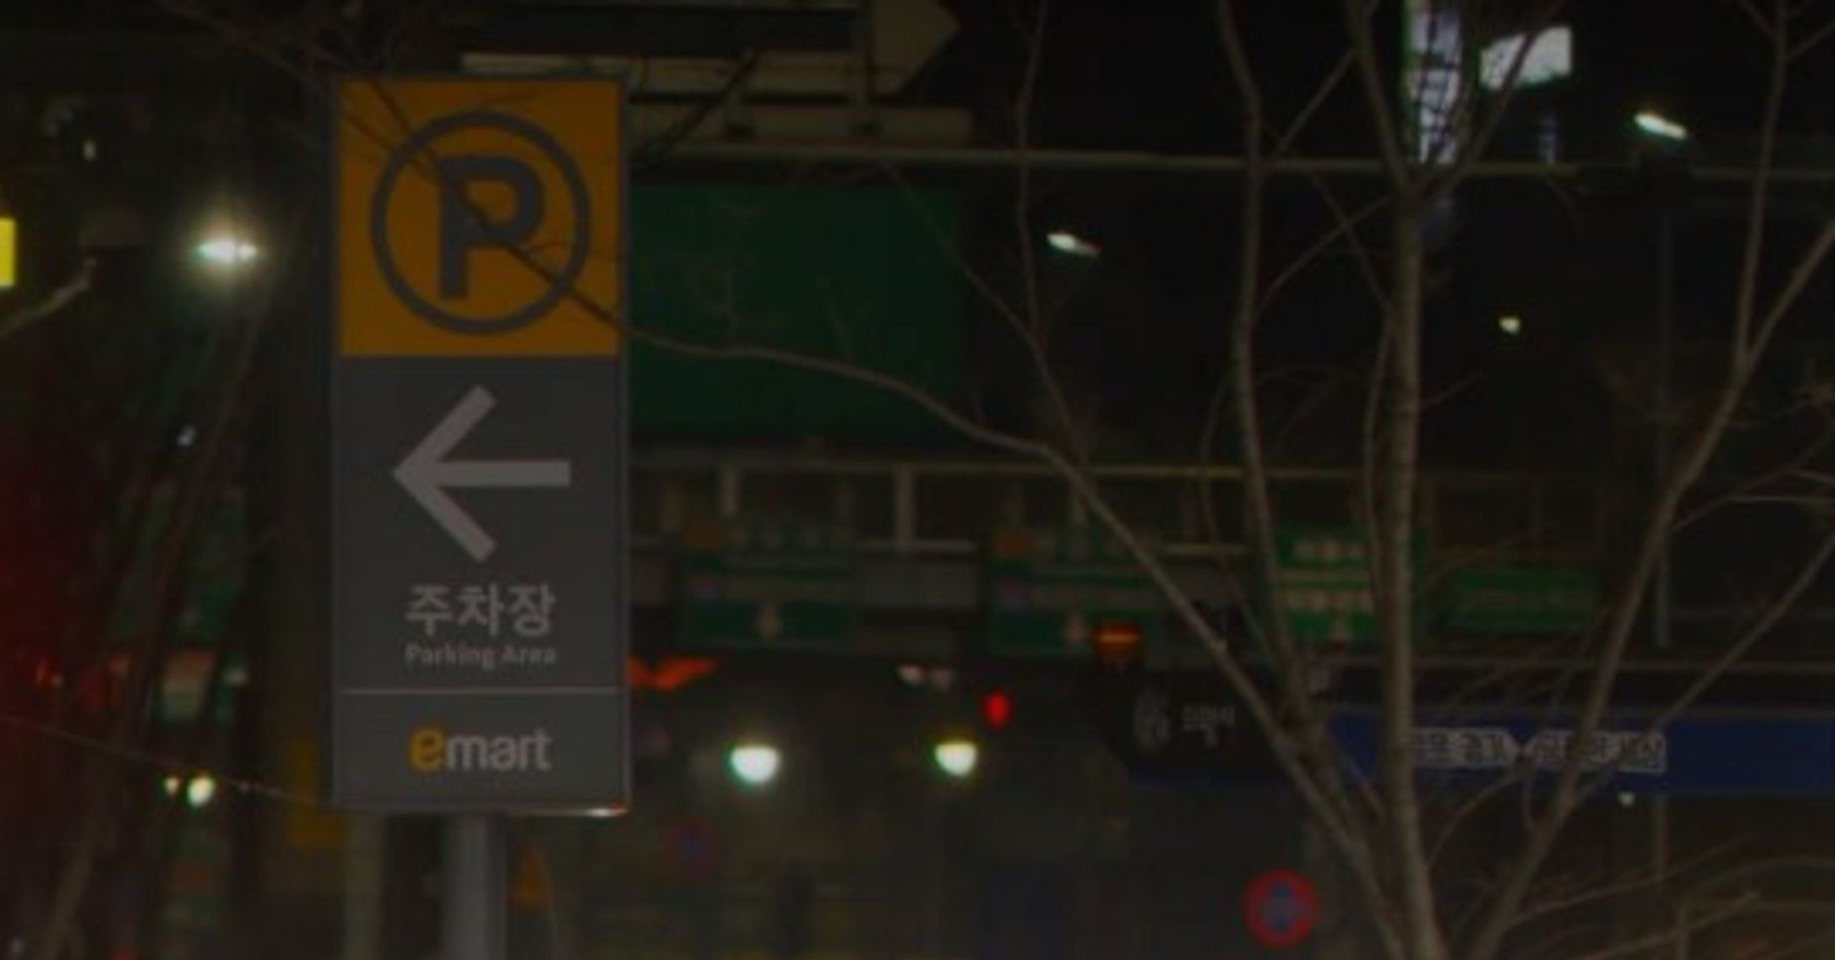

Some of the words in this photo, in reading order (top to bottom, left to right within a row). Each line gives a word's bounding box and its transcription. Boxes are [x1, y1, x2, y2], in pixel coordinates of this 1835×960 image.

[440, 156, 543, 299] P
[405, 583, 557, 637] 주차장
[405, 643, 494, 671] Parking
[502, 646, 556, 666] Area
[411, 726, 552, 771] emart
